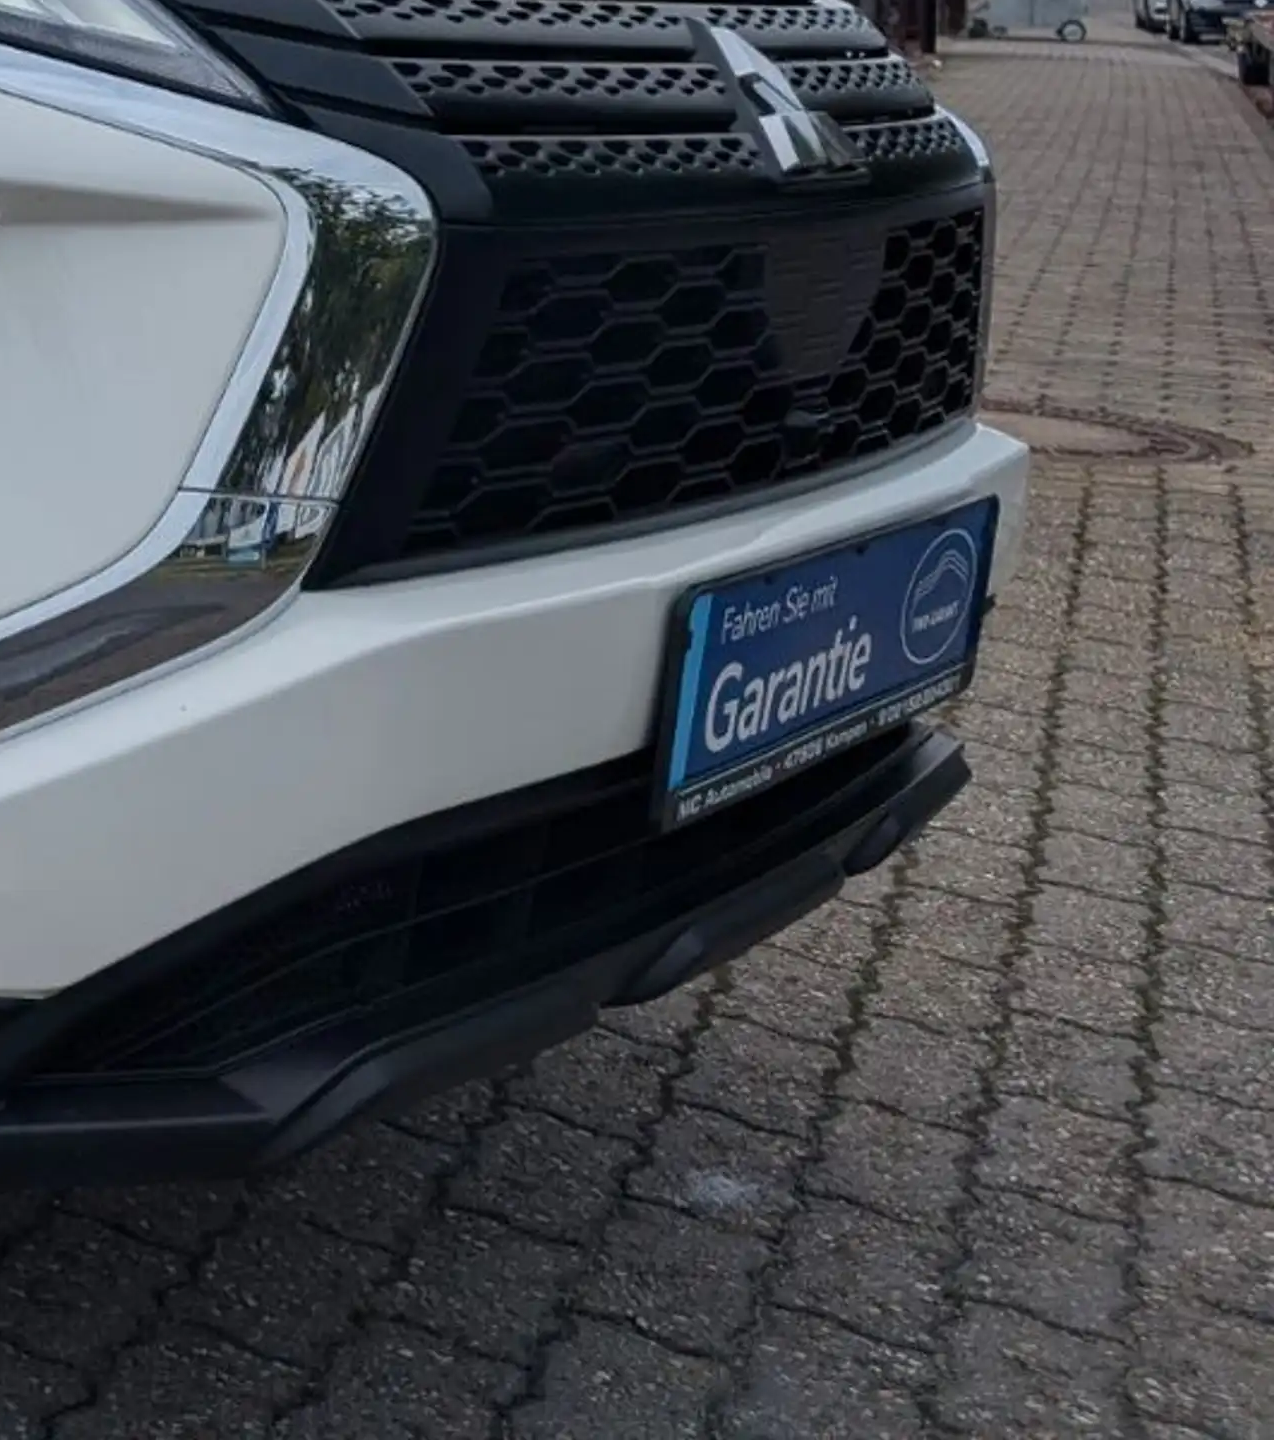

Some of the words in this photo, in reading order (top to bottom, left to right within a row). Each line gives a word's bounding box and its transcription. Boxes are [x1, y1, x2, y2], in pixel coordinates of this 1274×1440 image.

[719, 598, 781, 646] Fahren
[782, 587, 810, 624] Sie
[811, 574, 839, 615] mit
[703, 615, 873, 753] Garantie
